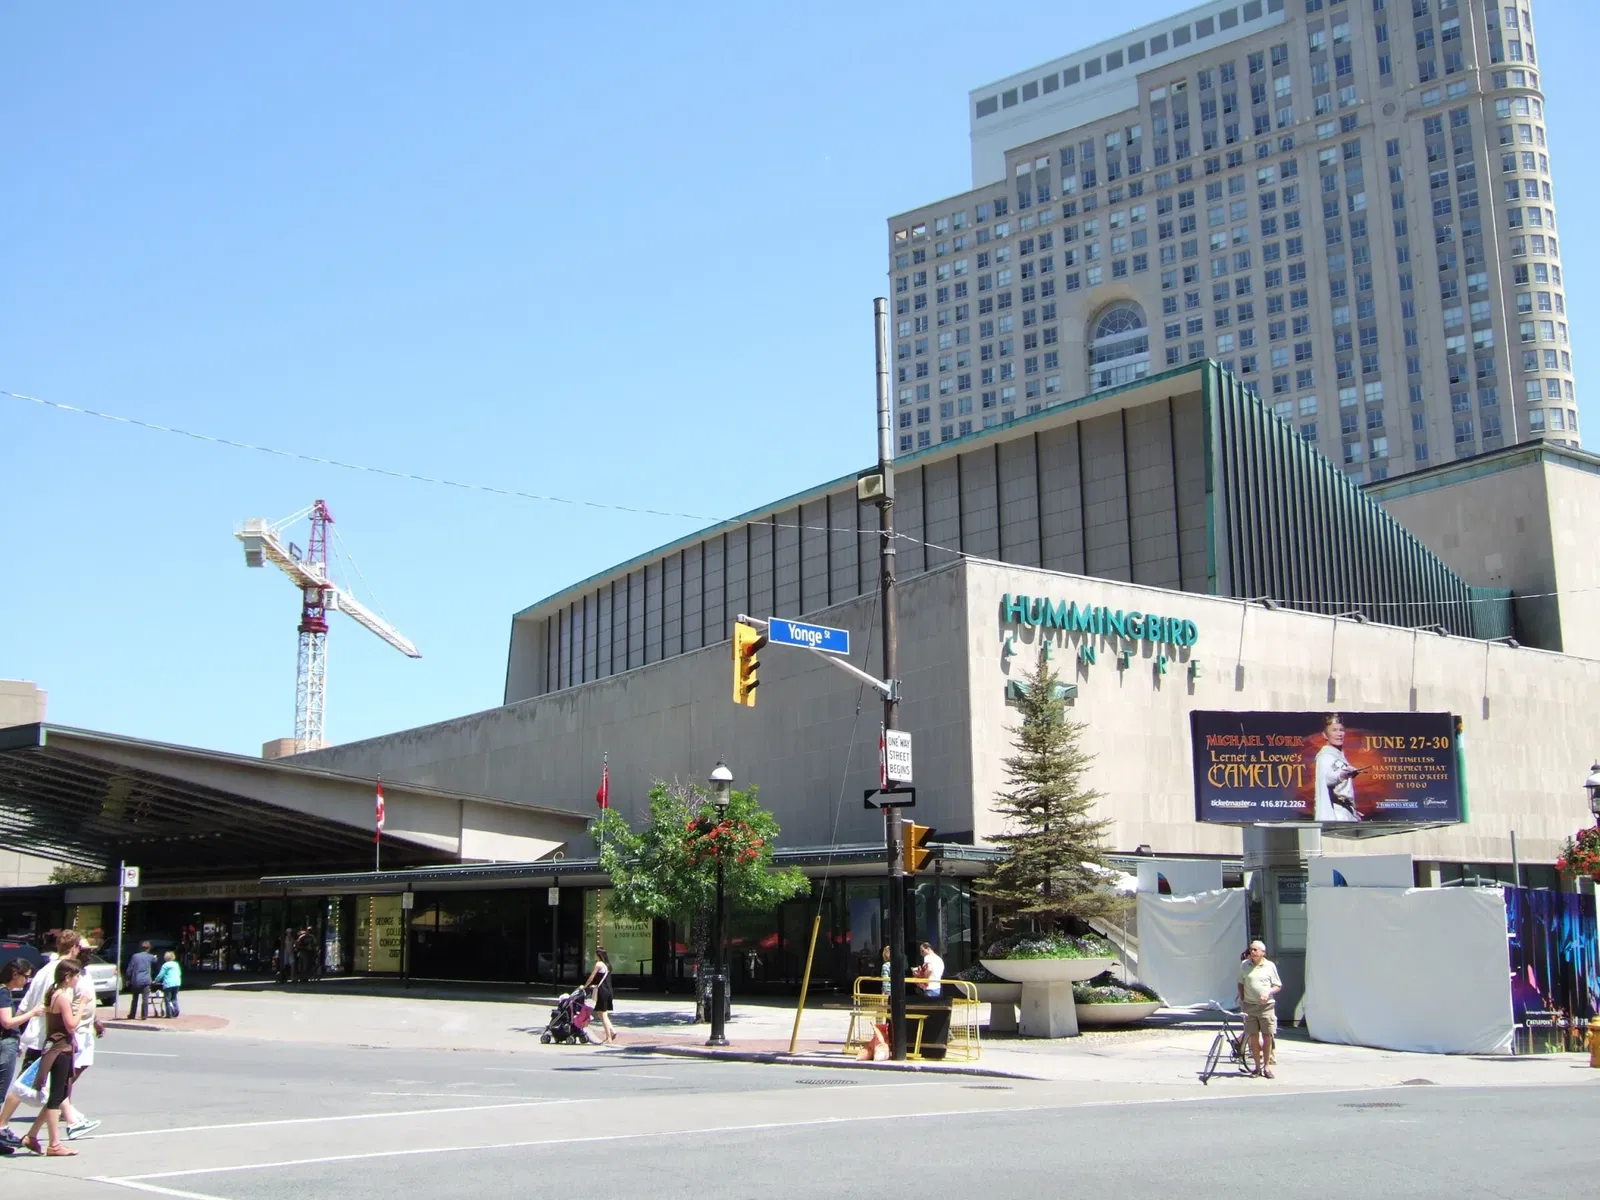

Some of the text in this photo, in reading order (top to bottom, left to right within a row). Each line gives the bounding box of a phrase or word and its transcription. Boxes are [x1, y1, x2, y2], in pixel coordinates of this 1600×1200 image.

[1003, 593, 1198, 647] HUMMINGBIRD
[788, 623, 831, 646] Yonge St
[1004, 635, 1202, 678] CENTRE
[888, 736, 910, 748] ONE WAY
[1206, 734, 1304, 750] MICHAEL YORK
[1363, 736, 1449, 752] JUNE 27-30
[889, 750, 910, 762] STREET
[1211, 750, 1302, 762] Lerner & Loewe's
[889, 764, 910, 775] BEGINS
[1207, 763, 1306, 788] CAMELOT
[1211, 799, 1306, 808] ticketmaster.ca 416.872.2262
[376, 916, 394, 926] GEORGE
